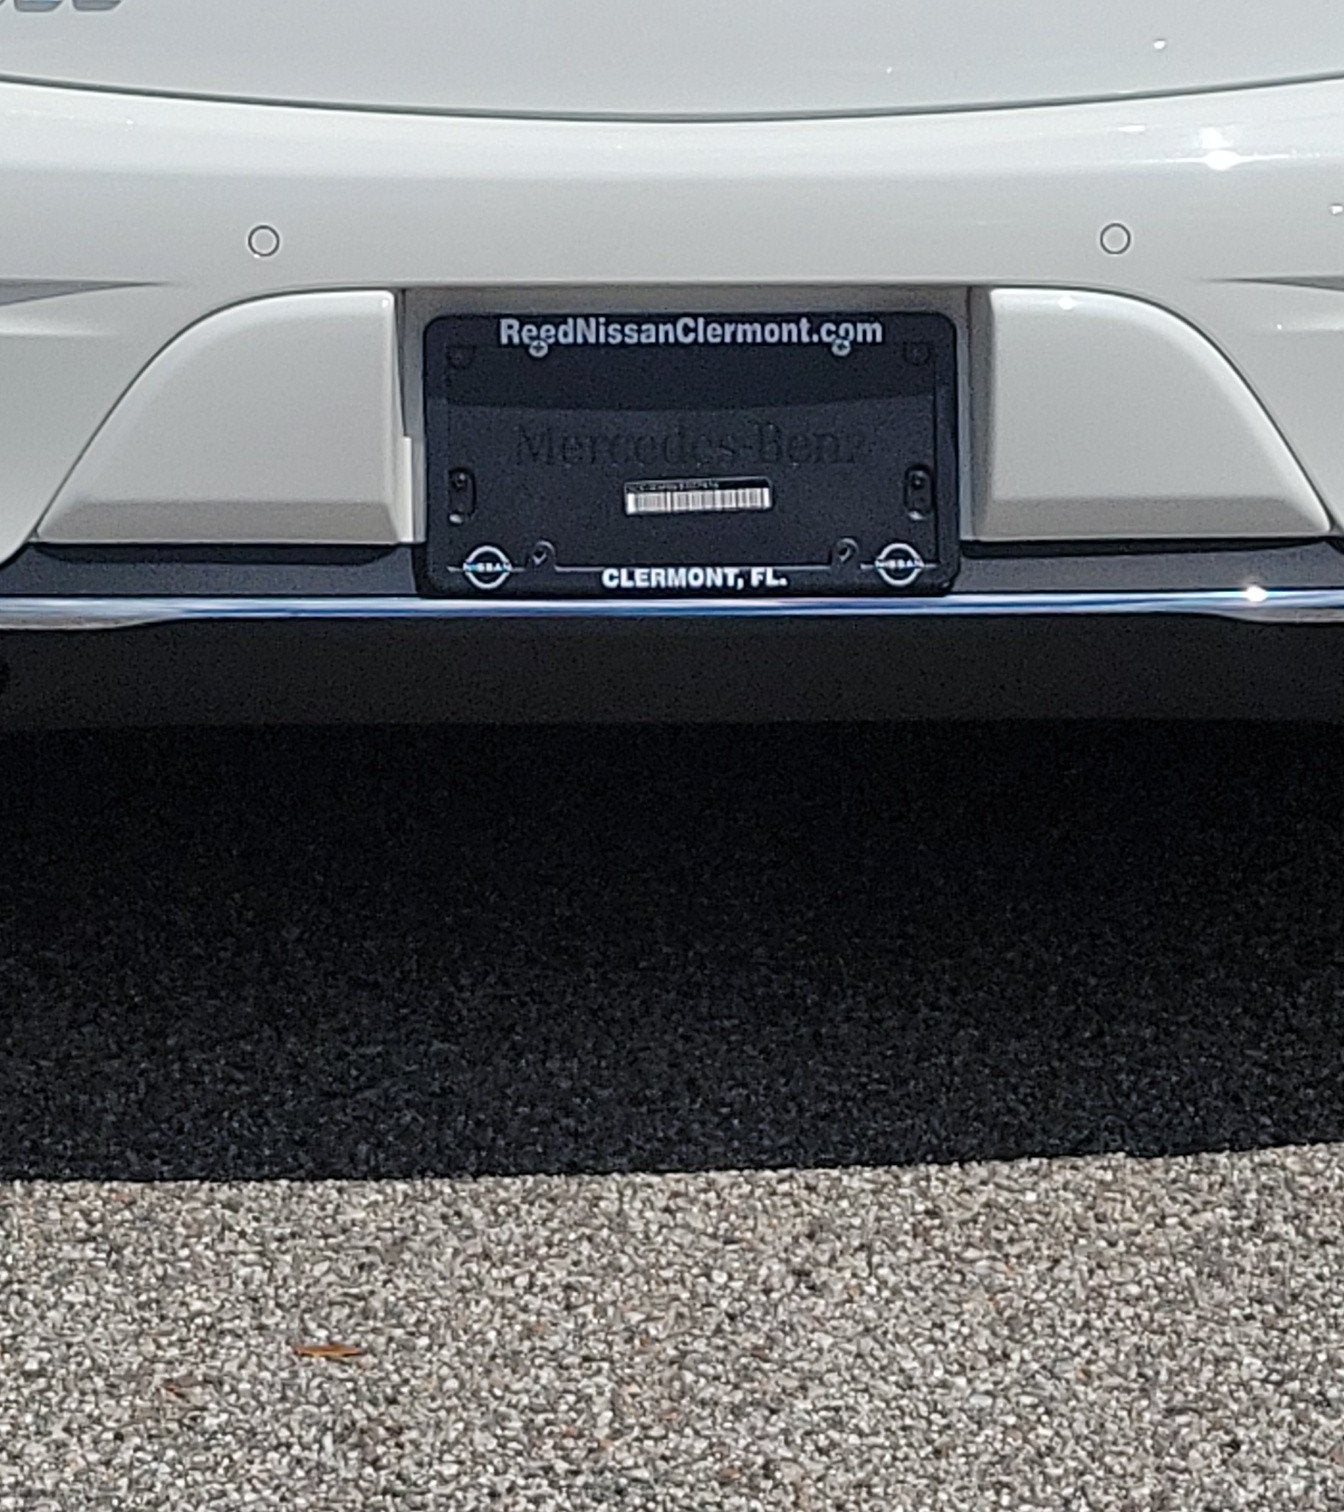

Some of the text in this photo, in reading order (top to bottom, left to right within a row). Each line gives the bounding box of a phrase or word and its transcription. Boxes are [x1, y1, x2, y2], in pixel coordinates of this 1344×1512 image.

[499, 318, 884, 345] ReedNissanClermont.com
[601, 567, 788, 590] CLERMONT, FL.
